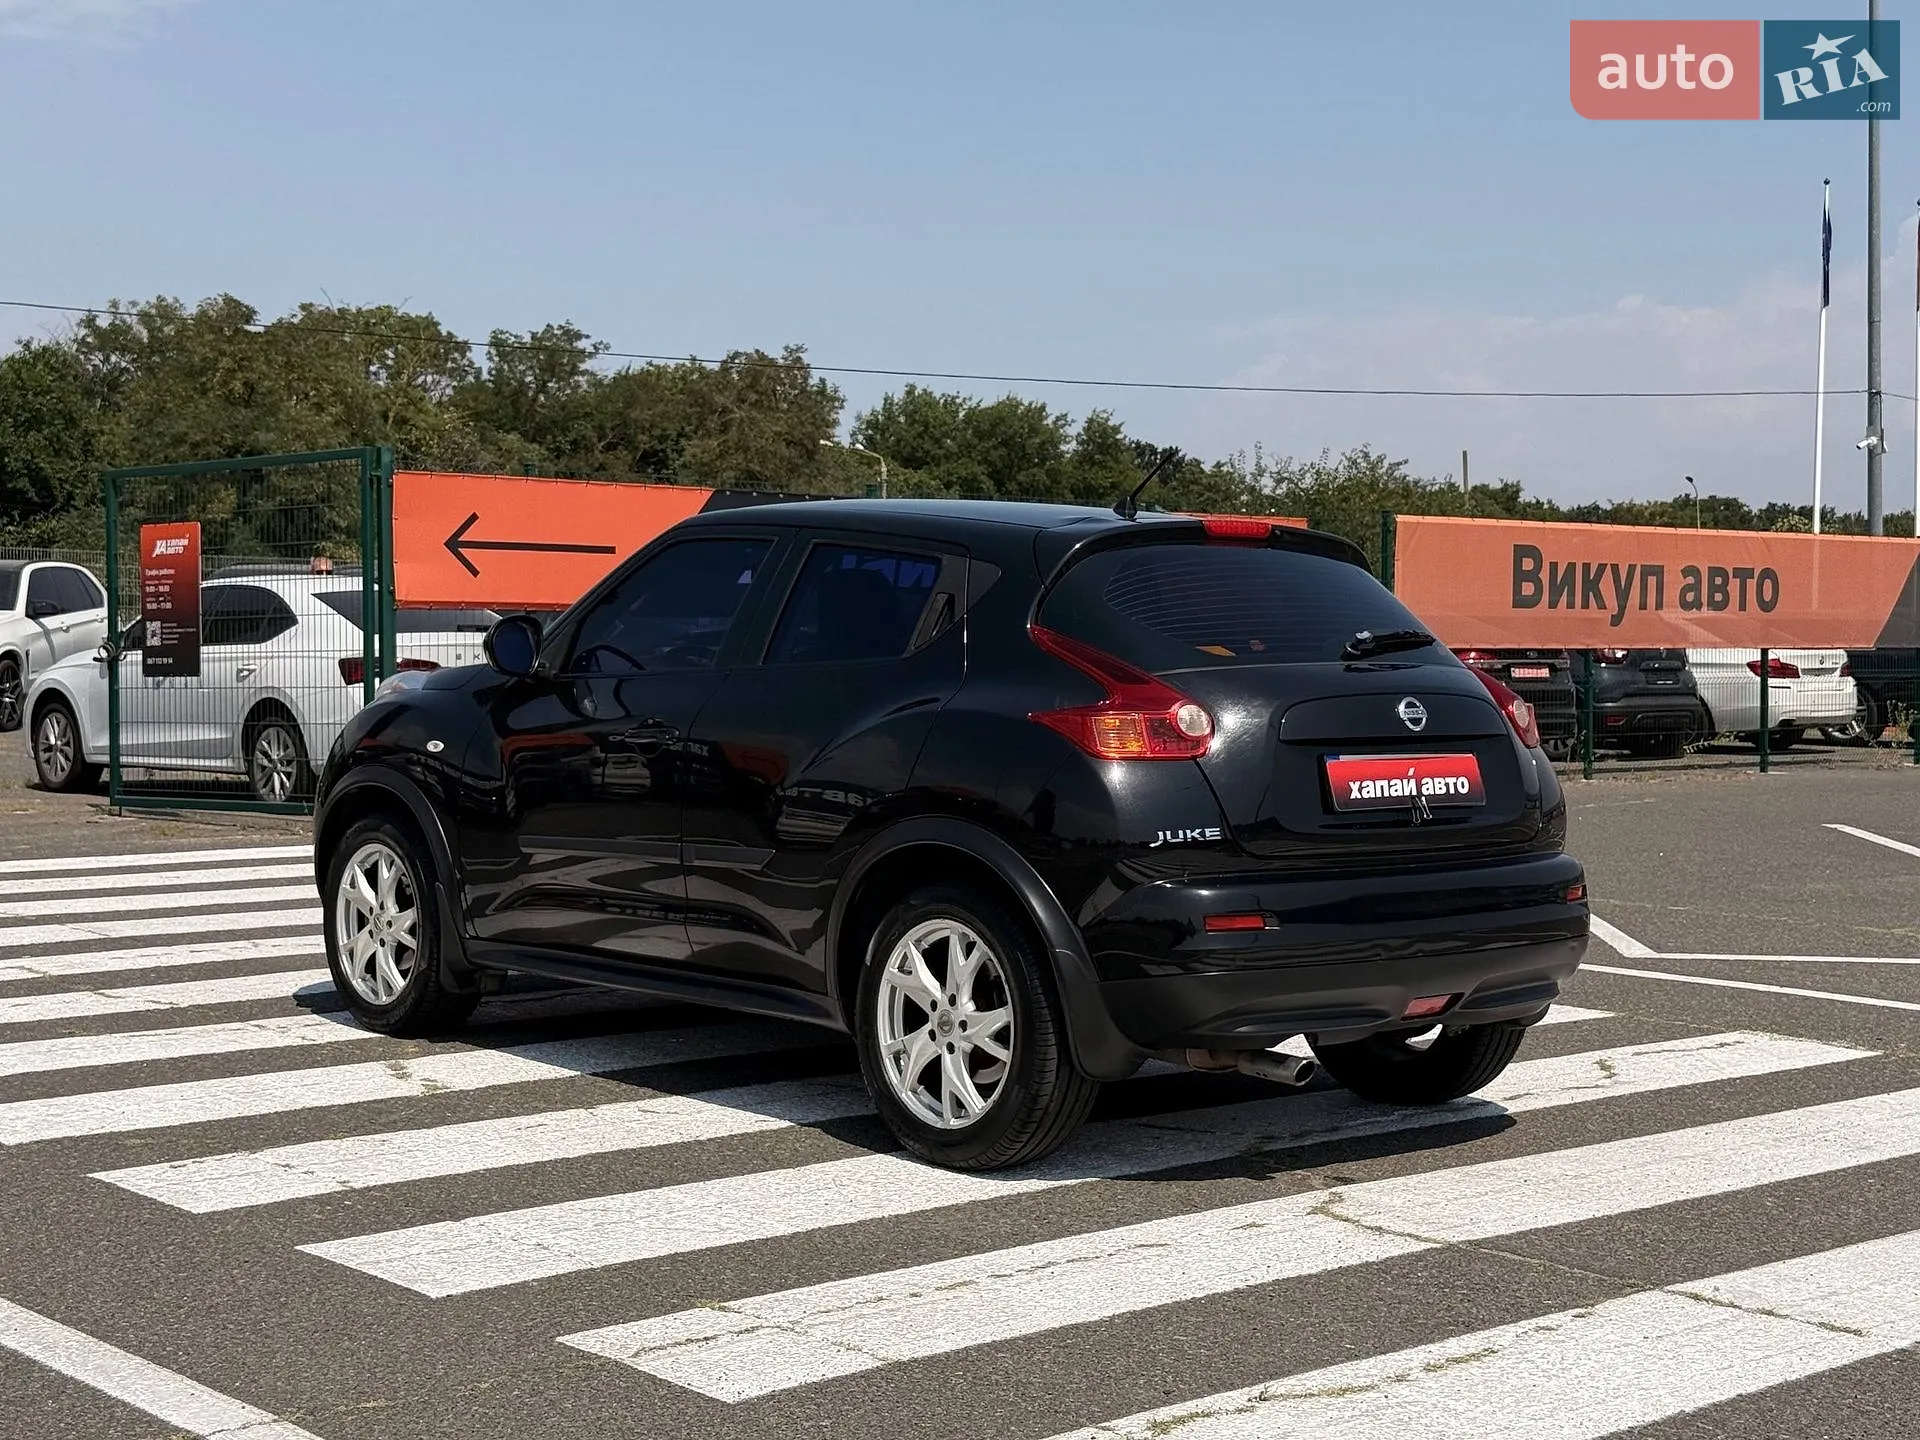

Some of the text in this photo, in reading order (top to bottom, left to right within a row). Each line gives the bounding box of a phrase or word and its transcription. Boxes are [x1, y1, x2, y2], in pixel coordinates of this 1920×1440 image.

[1511, 543, 1780, 628] Викуп авто
[1348, 767, 1470, 800] хапай авто
[1148, 827, 1222, 848] JUKE
